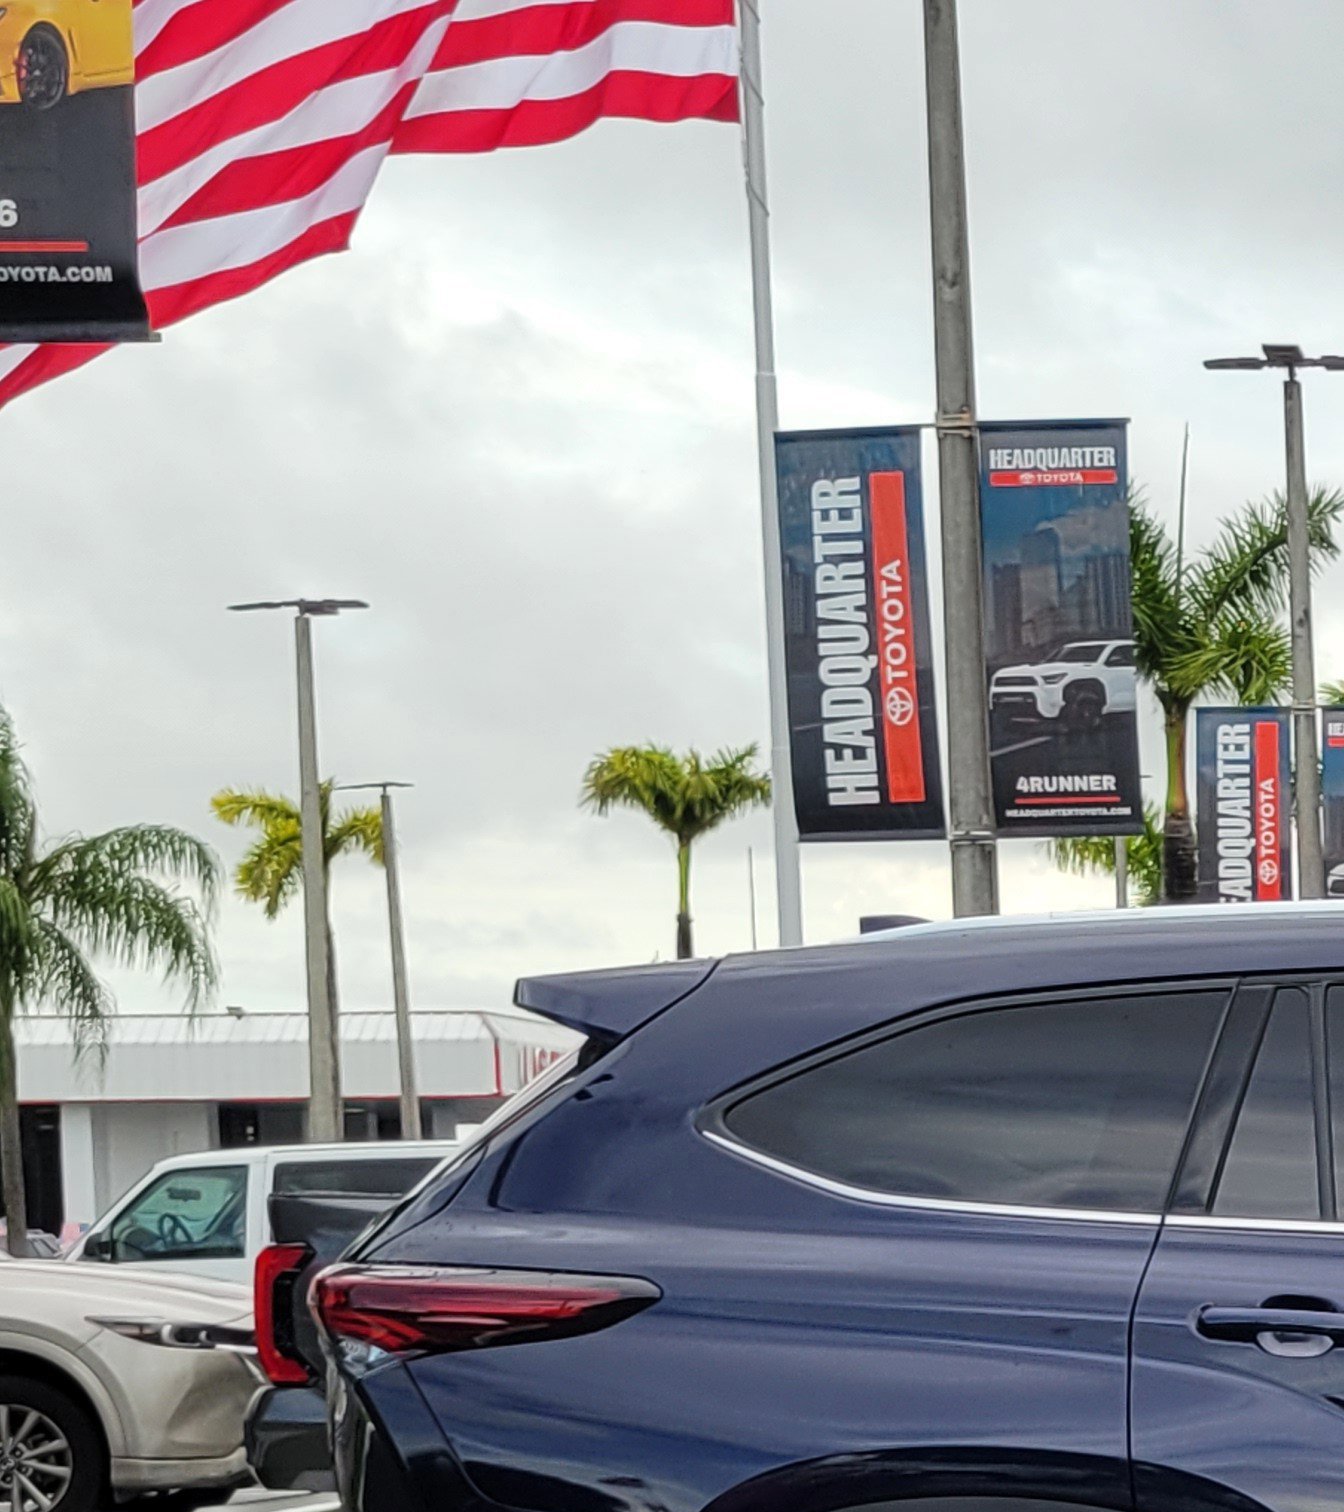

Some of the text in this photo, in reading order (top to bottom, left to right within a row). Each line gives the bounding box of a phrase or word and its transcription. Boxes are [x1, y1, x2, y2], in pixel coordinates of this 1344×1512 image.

[989, 446, 1116, 471] HEADQUARTER
[1036, 472, 1084, 483] TOYOTA
[810, 475, 880, 806] HEADQUARTER
[881, 559, 908, 683] TOYOTA
[1015, 775, 1117, 793] 4RUNNER
[1216, 723, 1256, 903] ADQUARTER
[1259, 778, 1275, 857] TOYOTA
